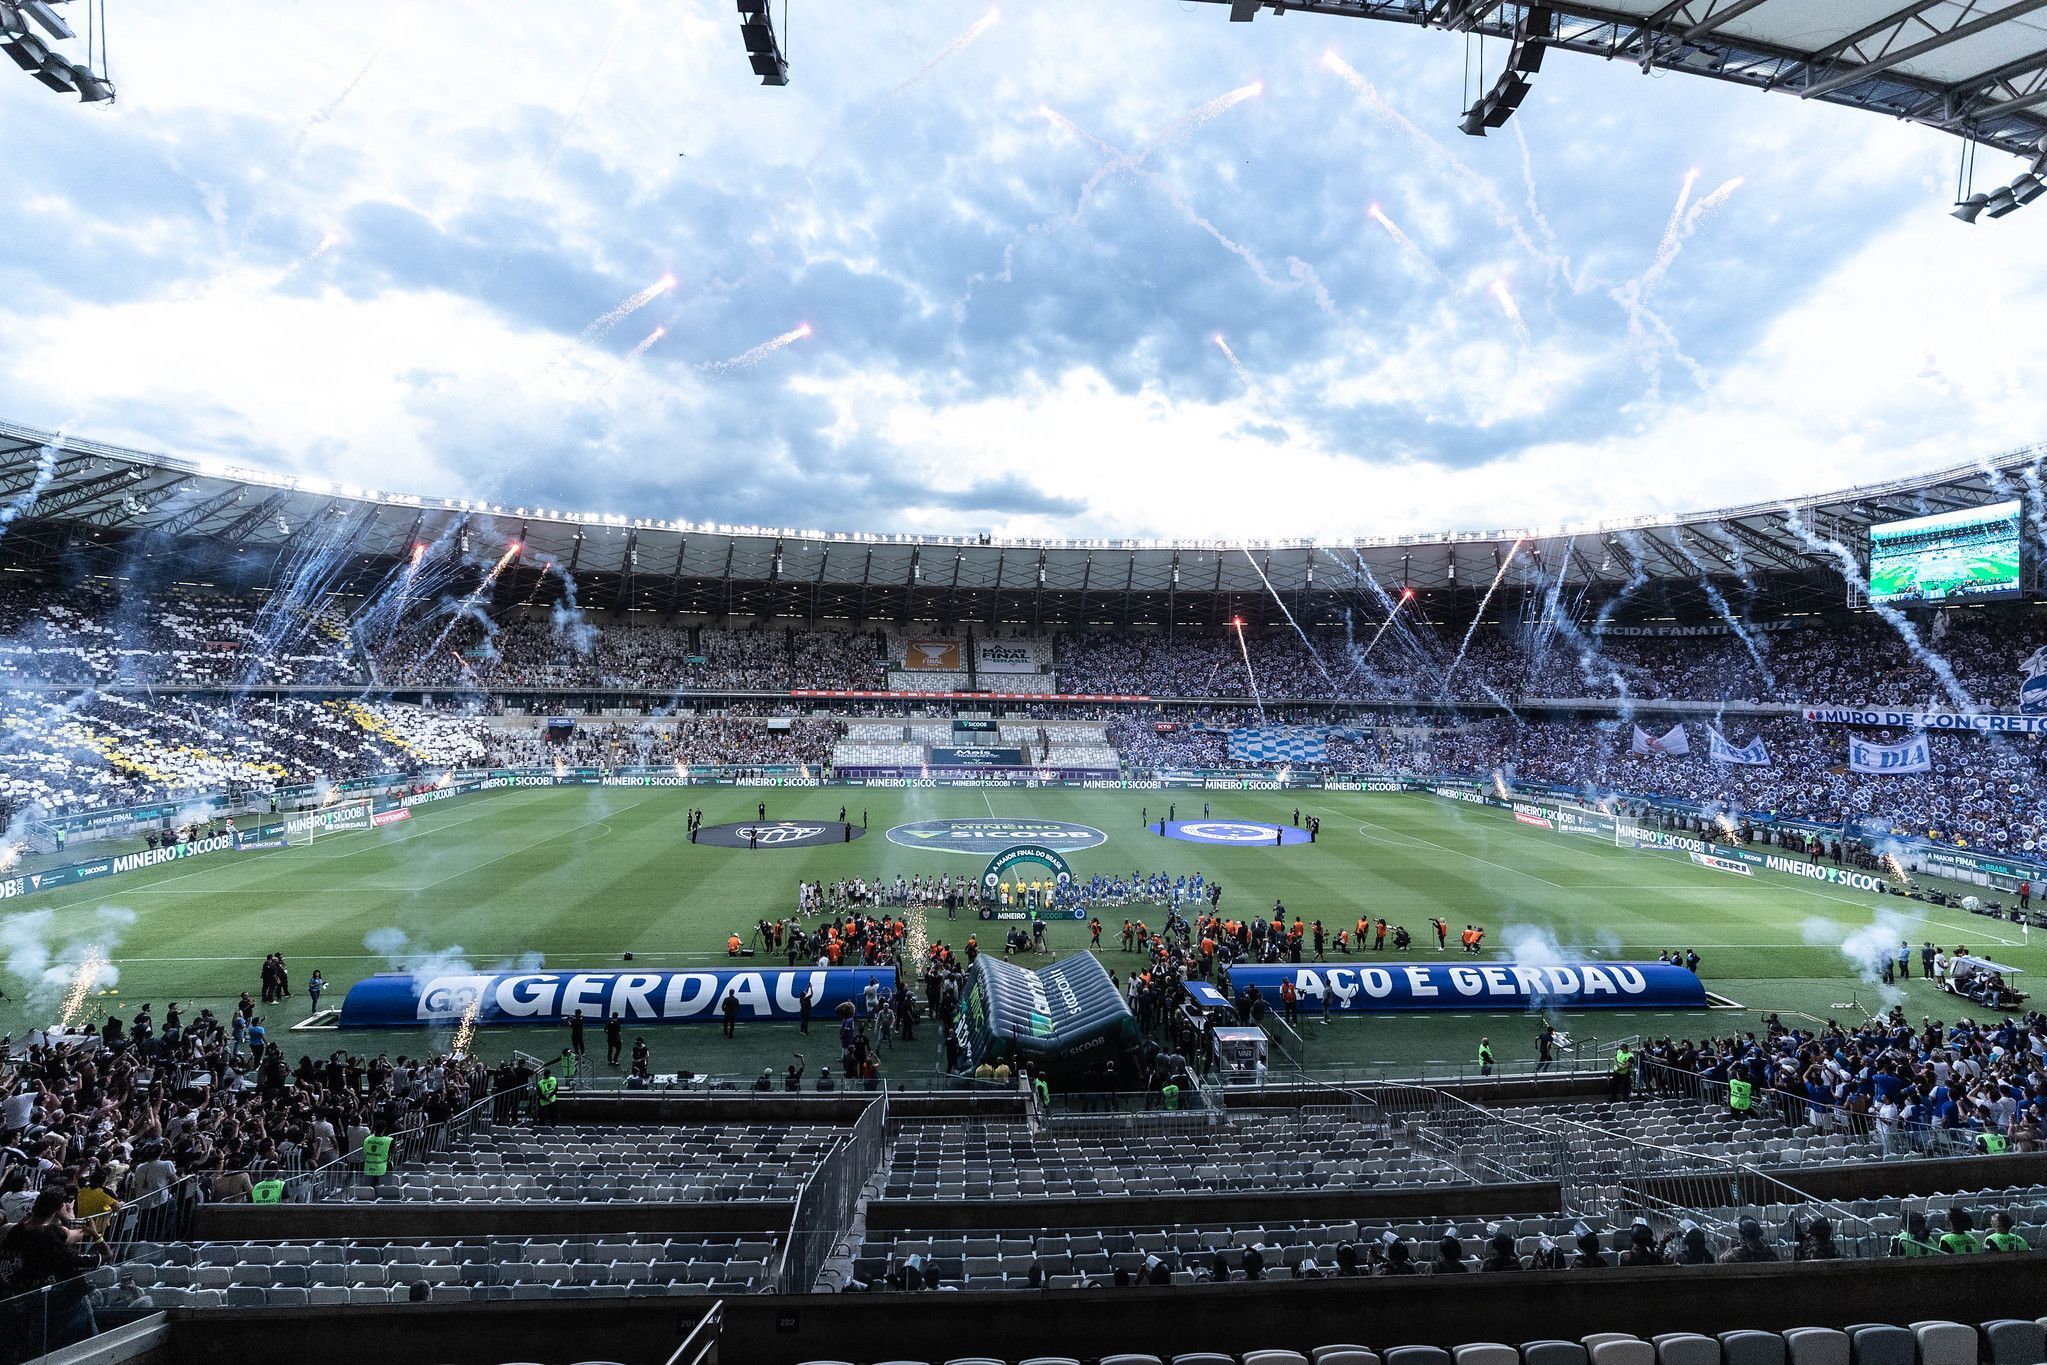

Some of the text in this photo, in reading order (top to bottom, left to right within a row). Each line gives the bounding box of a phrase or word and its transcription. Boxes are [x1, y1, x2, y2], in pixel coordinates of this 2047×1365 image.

[1826, 710, 1879, 724] MURO
[1886, 713, 1914, 726] DE
[1879, 744, 1926, 768] DIA
[515, 776, 549, 786] SICOOB
[602, 776, 684, 786] MINEIRO SICOOB
[736, 777, 816, 787] MINEIRO SICOOB
[866, 779, 906, 788] MINEIRO
[1083, 780, 1158, 789] MINEIRO SICOOB
[1205, 781, 1278, 790] MINEIRO SICOOB
[1324, 782, 1397, 791] MINEIRO SICOOB
[400, 787, 454, 808] MINEIRO SICOOB
[1436, 787, 1459, 800] MINEIRO
[1462, 792, 1483, 805] SICOOB
[287, 807, 361, 834] MINEIRO SICOOB
[1513, 802, 1571, 823] MINEIRO SICOOB
[1617, 823, 1657, 843] MINEIRO
[1663, 833, 1701, 852] SICOOB
[85, 865, 108, 876] SICOOB
[113, 844, 176, 874] MINEIRO
[186, 835, 228, 857] SICOOB
[1045, 853, 1063, 870] BRASIL
[1766, 855, 1826, 881] MINEIRO
[997, 912, 1027, 920] MINEIRO
[496, 971, 826, 1019] GERDAU
[1295, 968, 1393, 1009] AÇO
[1448, 965, 1646, 996] GERDAU
[1070, 1036, 1105, 1056] SICOOB
[780, 1318, 795, 1327] 202
